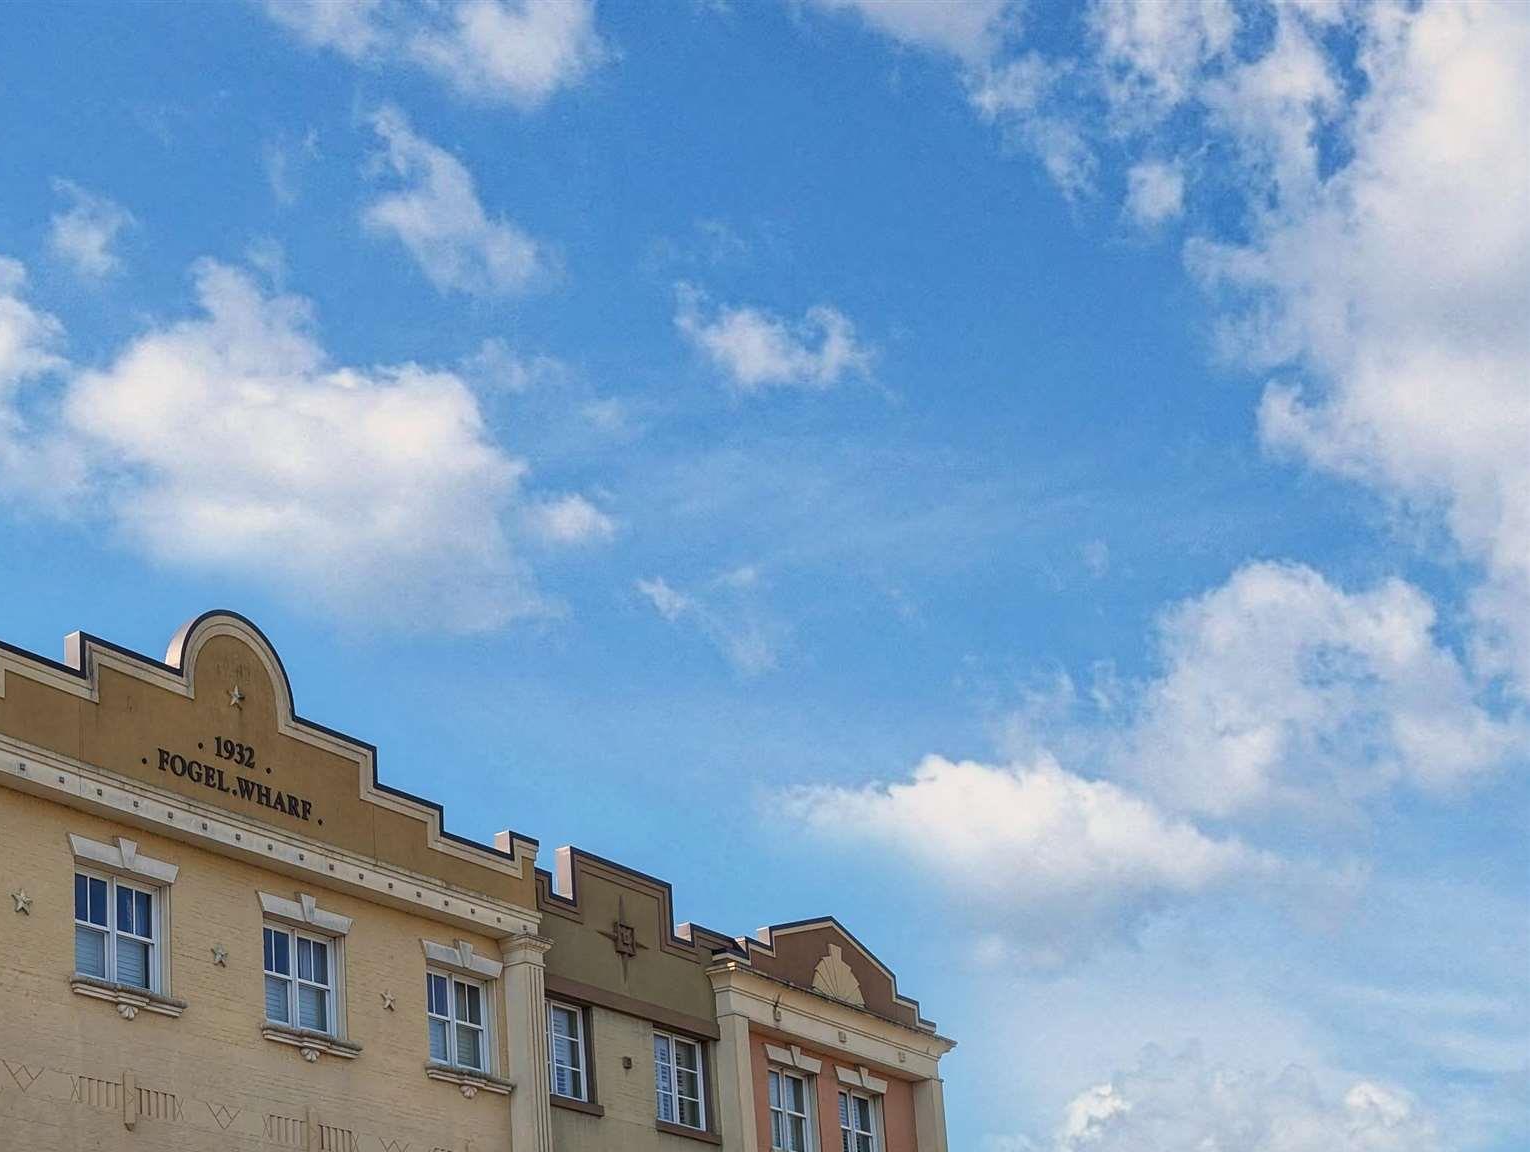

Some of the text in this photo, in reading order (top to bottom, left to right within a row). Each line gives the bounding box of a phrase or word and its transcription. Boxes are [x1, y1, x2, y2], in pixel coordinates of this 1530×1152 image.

[215, 736, 256, 769] 1932
[157, 748, 312, 821] FOGEL WHARF
